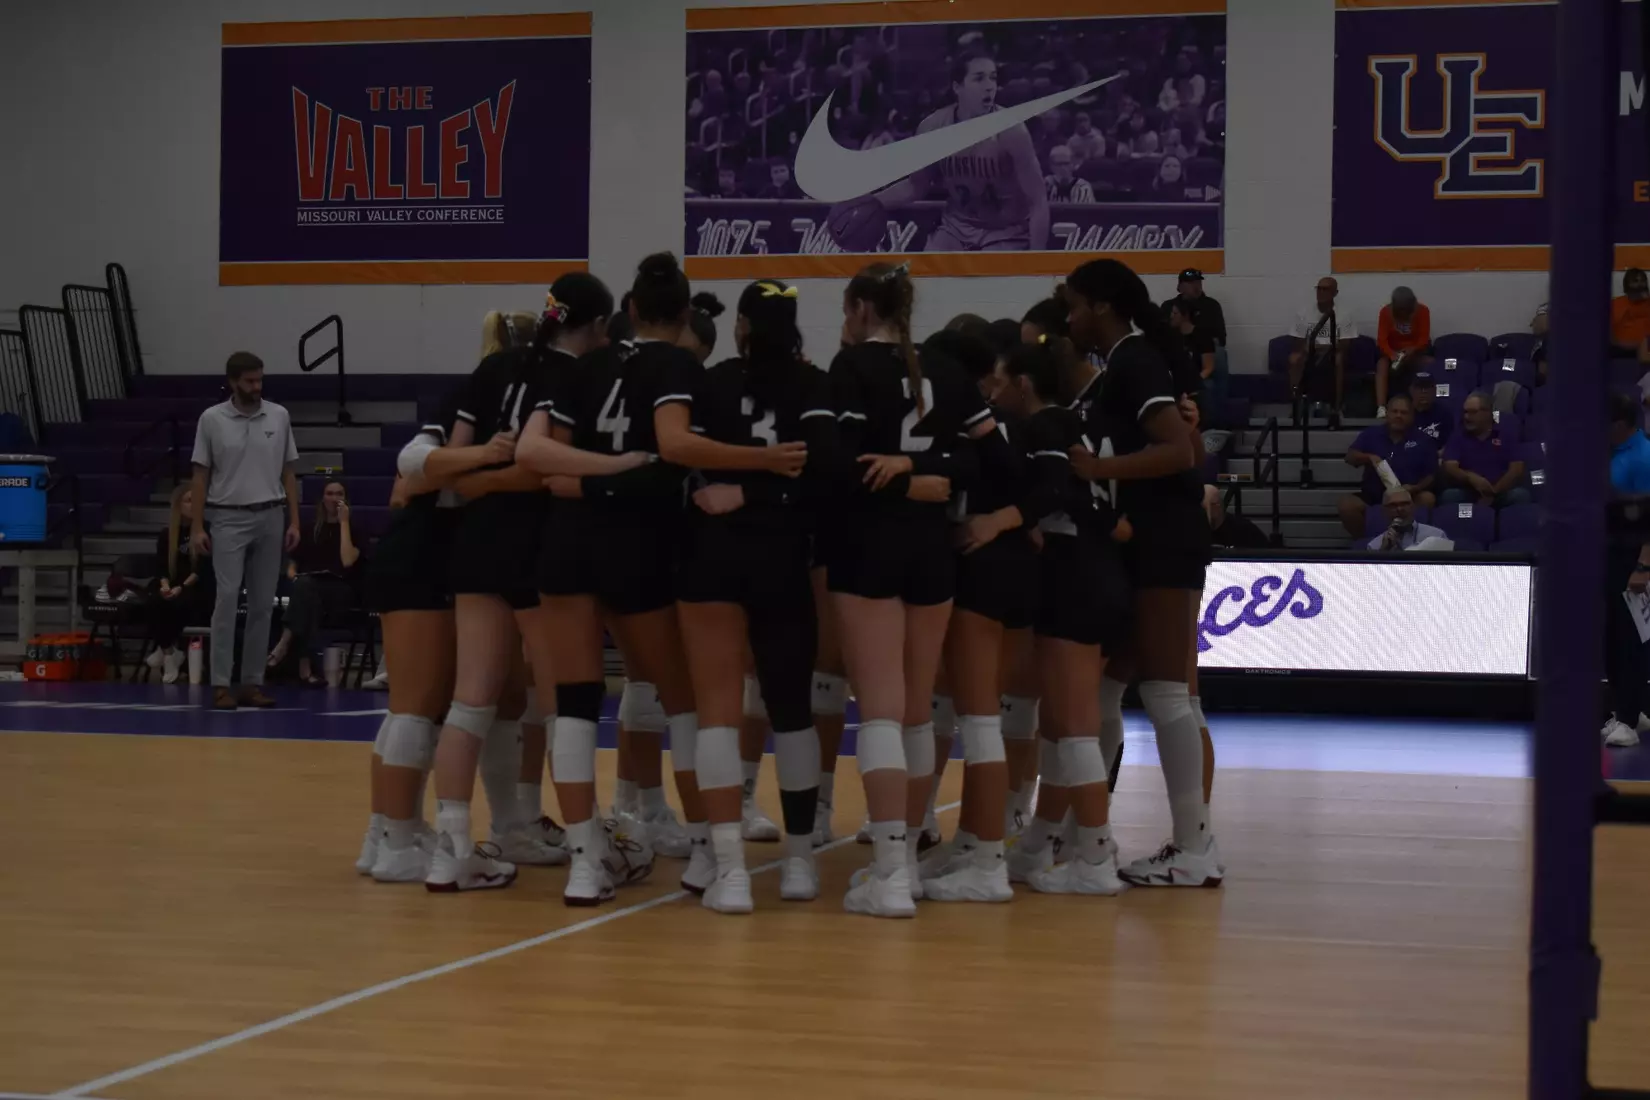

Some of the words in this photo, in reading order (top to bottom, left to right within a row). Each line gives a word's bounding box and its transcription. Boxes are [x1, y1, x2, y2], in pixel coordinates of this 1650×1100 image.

[366, 86, 434, 111] THE
[292, 79, 517, 201] VALLEY
[297, 210, 360, 223] MISSOURI
[366, 210, 413, 222] VALLEY
[416, 208, 504, 221] CONFERENCE
[595, 377, 632, 451] 4
[899, 377, 935, 452] 2
[36, 663, 47, 677] G
